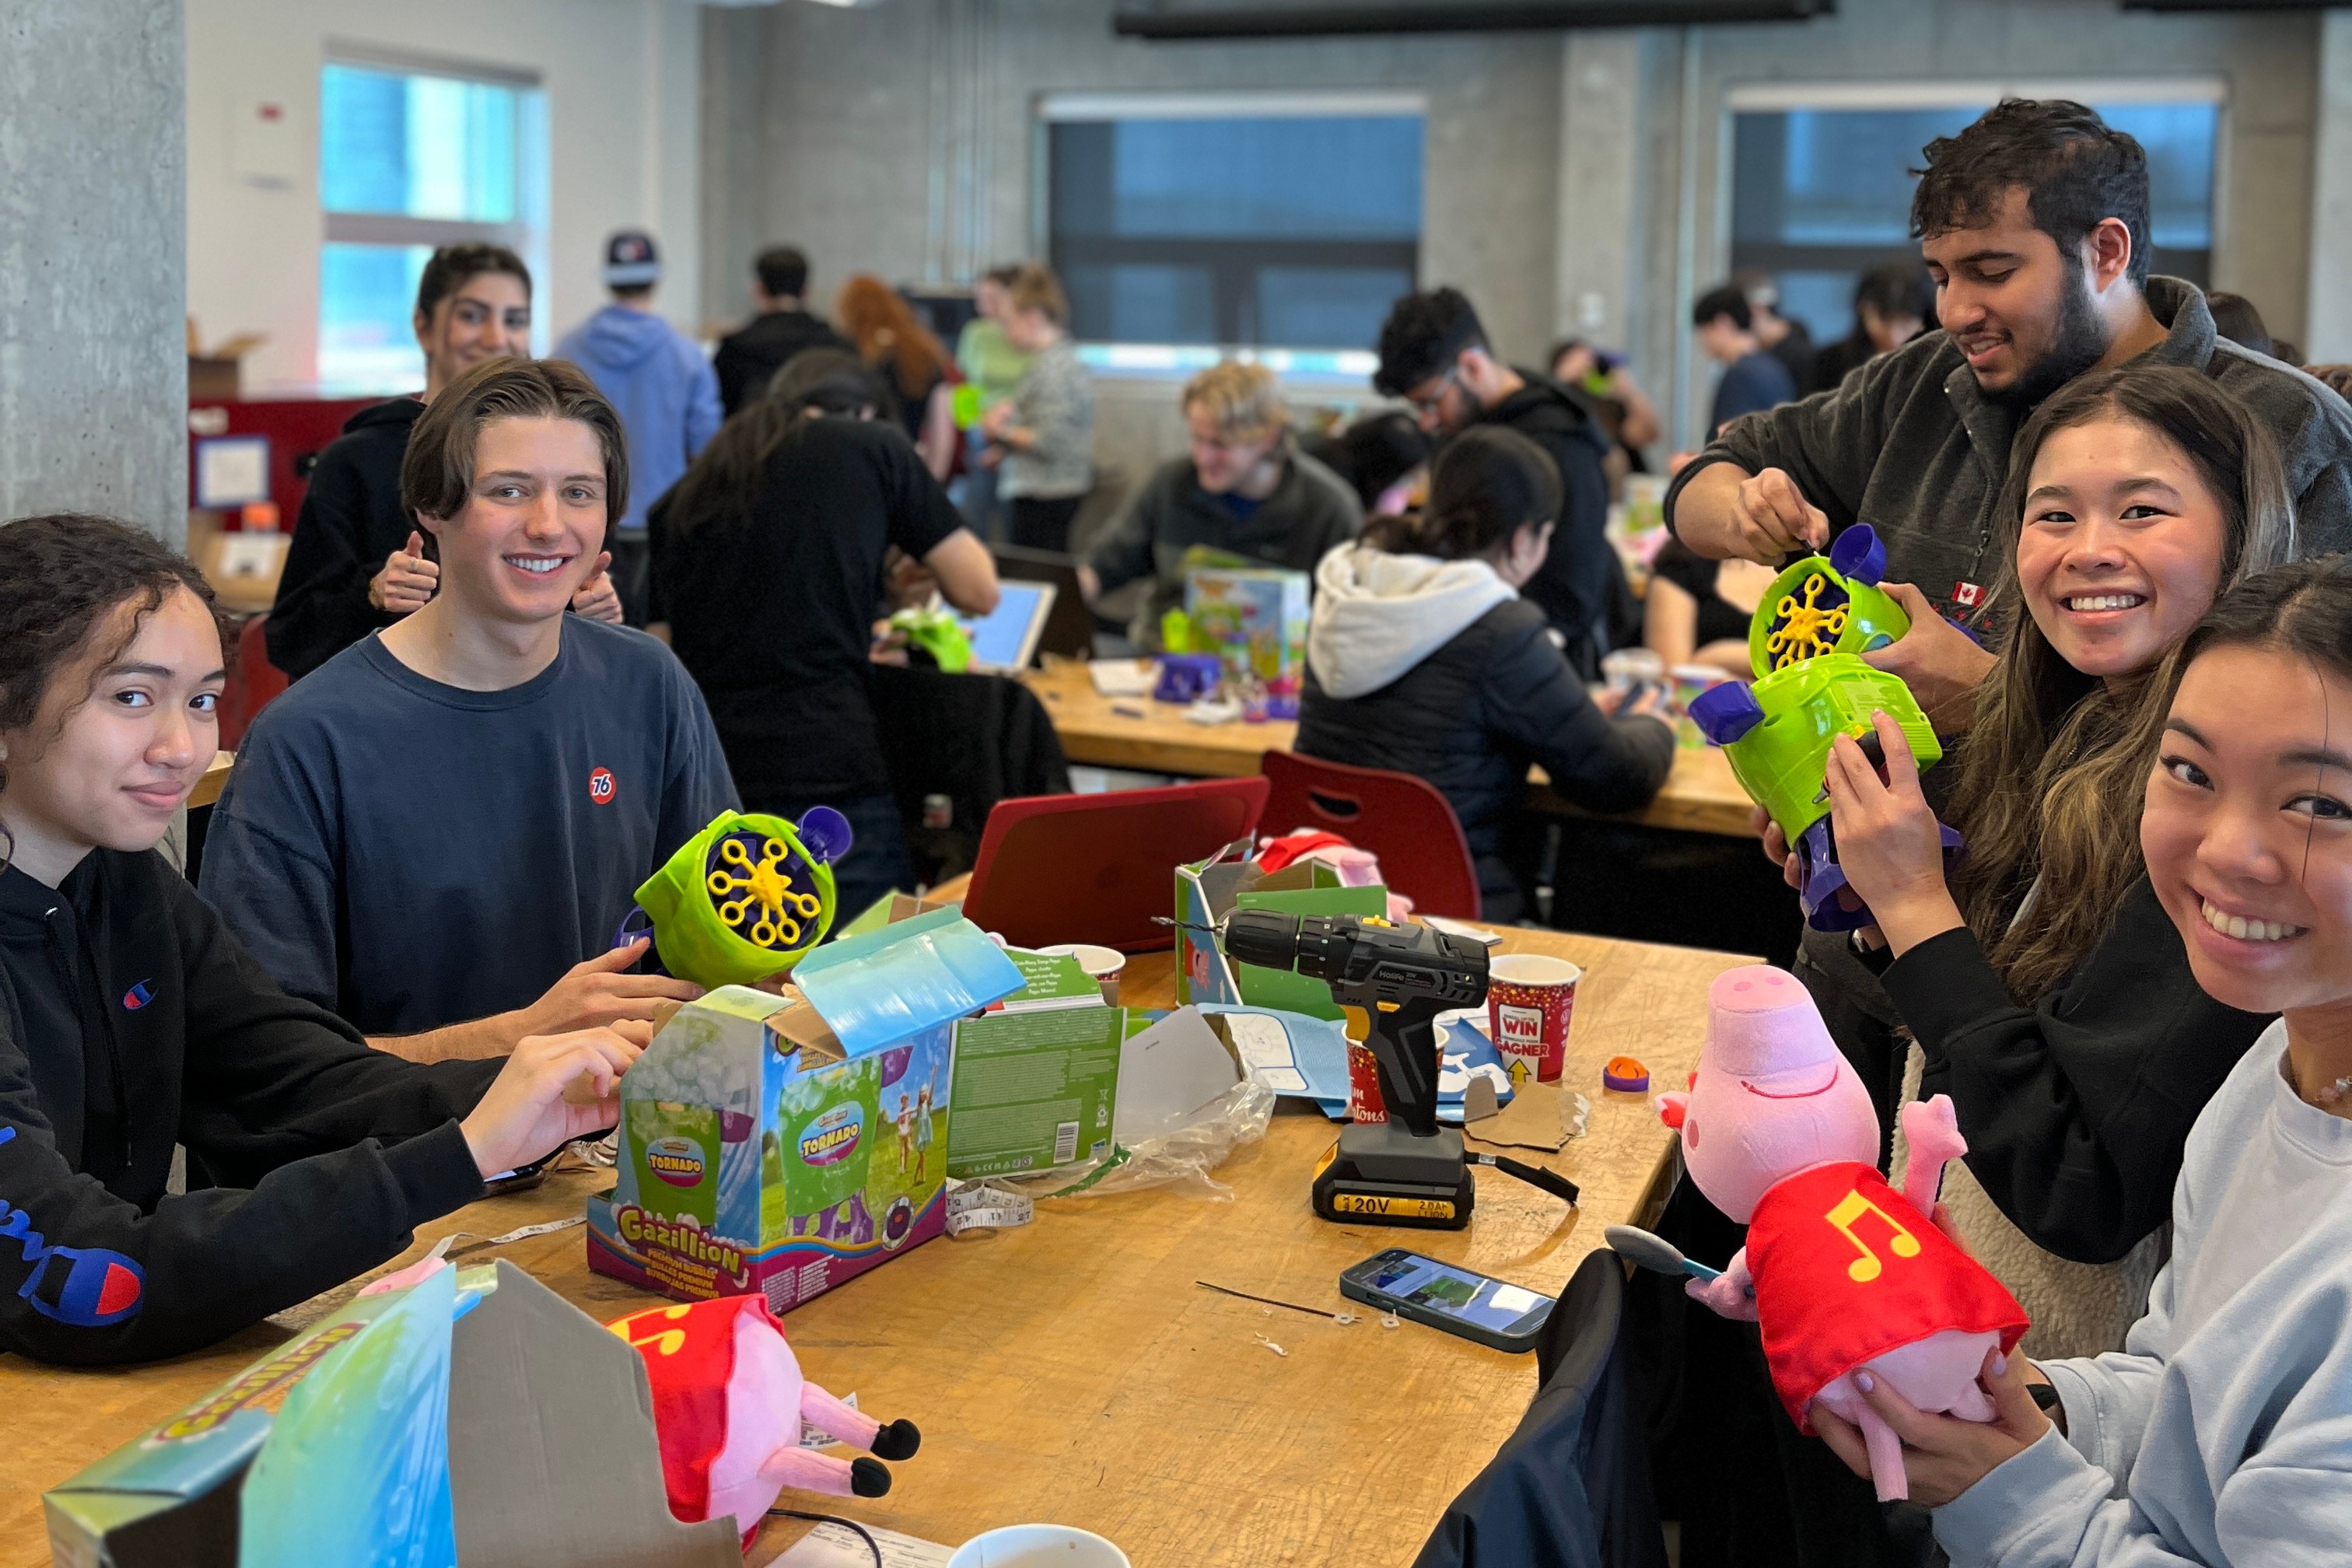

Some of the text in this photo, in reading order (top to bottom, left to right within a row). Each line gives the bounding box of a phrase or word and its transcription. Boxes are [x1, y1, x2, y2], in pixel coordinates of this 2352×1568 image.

[591, 773, 612, 796] 76
[1503, 1017, 1538, 1037] WIN
[1496, 1038, 1549, 1057] GAGNER
[803, 1122, 859, 1158] TORNADO
[649, 1153, 702, 1173] TORNADO
[1354, 1197, 1390, 1213] 20V
